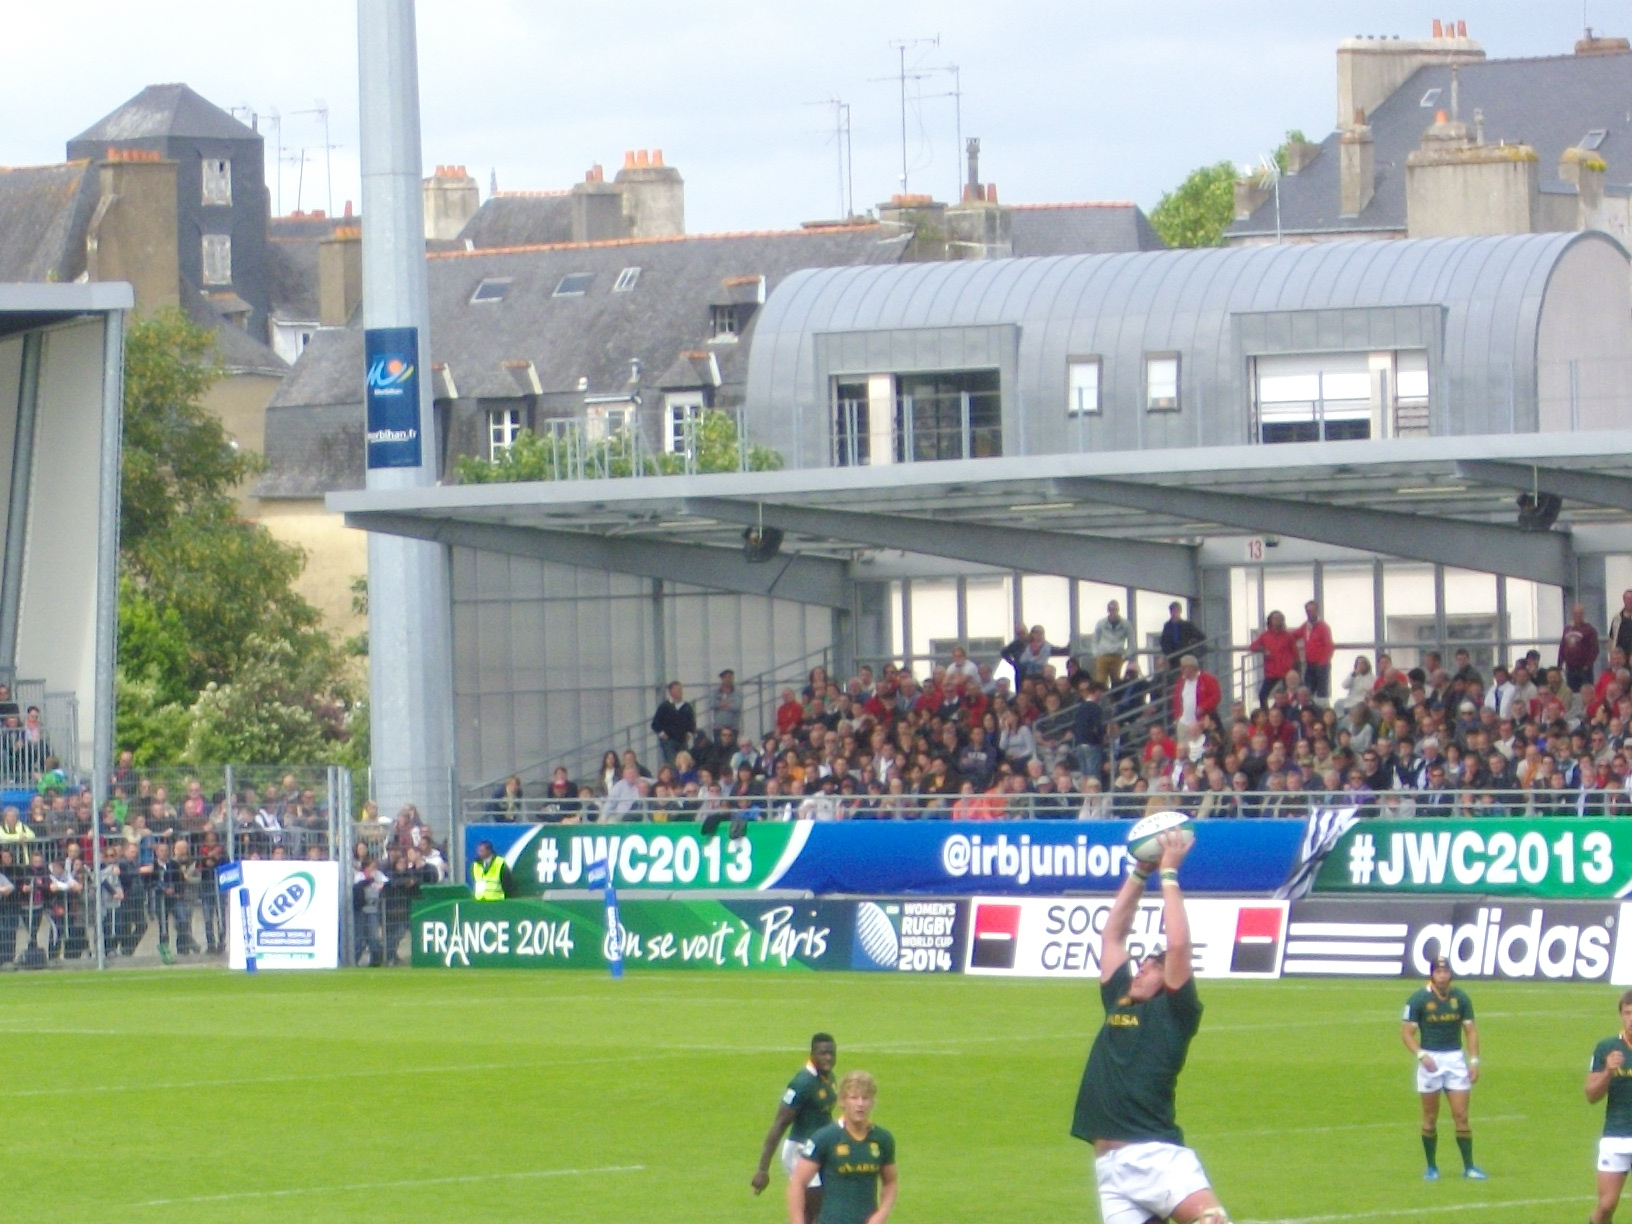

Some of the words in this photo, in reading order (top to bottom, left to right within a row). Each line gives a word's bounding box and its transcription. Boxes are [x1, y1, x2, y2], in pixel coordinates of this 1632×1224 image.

[536, 834, 753, 884] #JWC2013
[1349, 830, 1614, 885] #JWC2013
[422, 902, 510, 967] FRANCE
[515, 919, 575, 959] 2014
[648, 931, 678, 962] se
[682, 920, 735, 966] voit
[734, 919, 753, 967] à
[759, 905, 831, 968] Paris
[901, 916, 955, 935] RUGBY
[901, 936, 934, 948] WORLD
[934, 936, 954, 948] CUP
[1413, 907, 1611, 979] adidas
[899, 948, 953, 971] 2014
